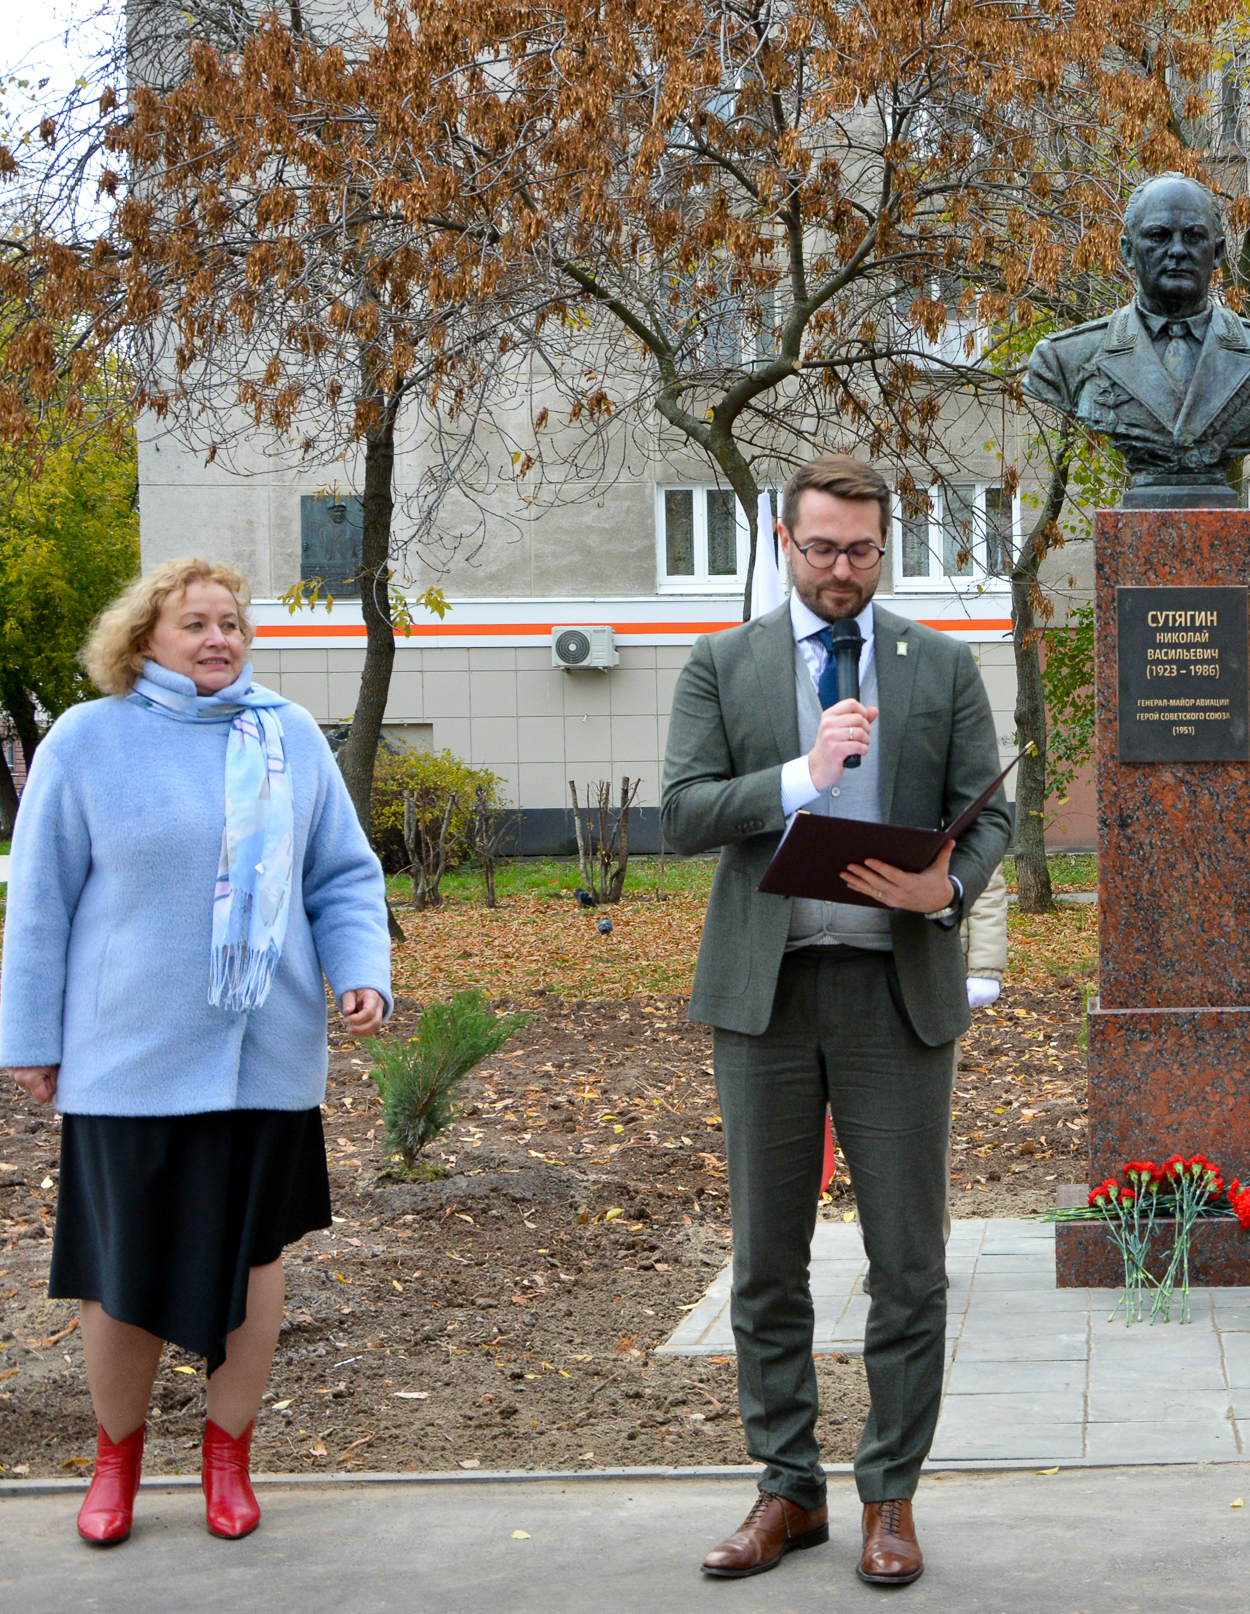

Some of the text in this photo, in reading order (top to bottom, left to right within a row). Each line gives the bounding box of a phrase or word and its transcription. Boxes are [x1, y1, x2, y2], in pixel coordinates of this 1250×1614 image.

[1148, 611, 1217, 627] СУТЯГИН
[1156, 630, 1209, 643] НИКОЛАЙ
[1147, 648, 1218, 660] ВАСИЛЬЕВИЧ
[1147, 665, 1177, 679] (1923
[1189, 664, 1219, 679] 1986)
[1137, 697, 1229, 707] ГЕНЕРАЛ-МАЙОР АВИАЦИИ
[1136, 711, 1159, 721] ГЕРОЙ
[1160, 712, 1205, 720] СОВЕТСКОГО
[1172, 726, 1195, 736] (1951)
